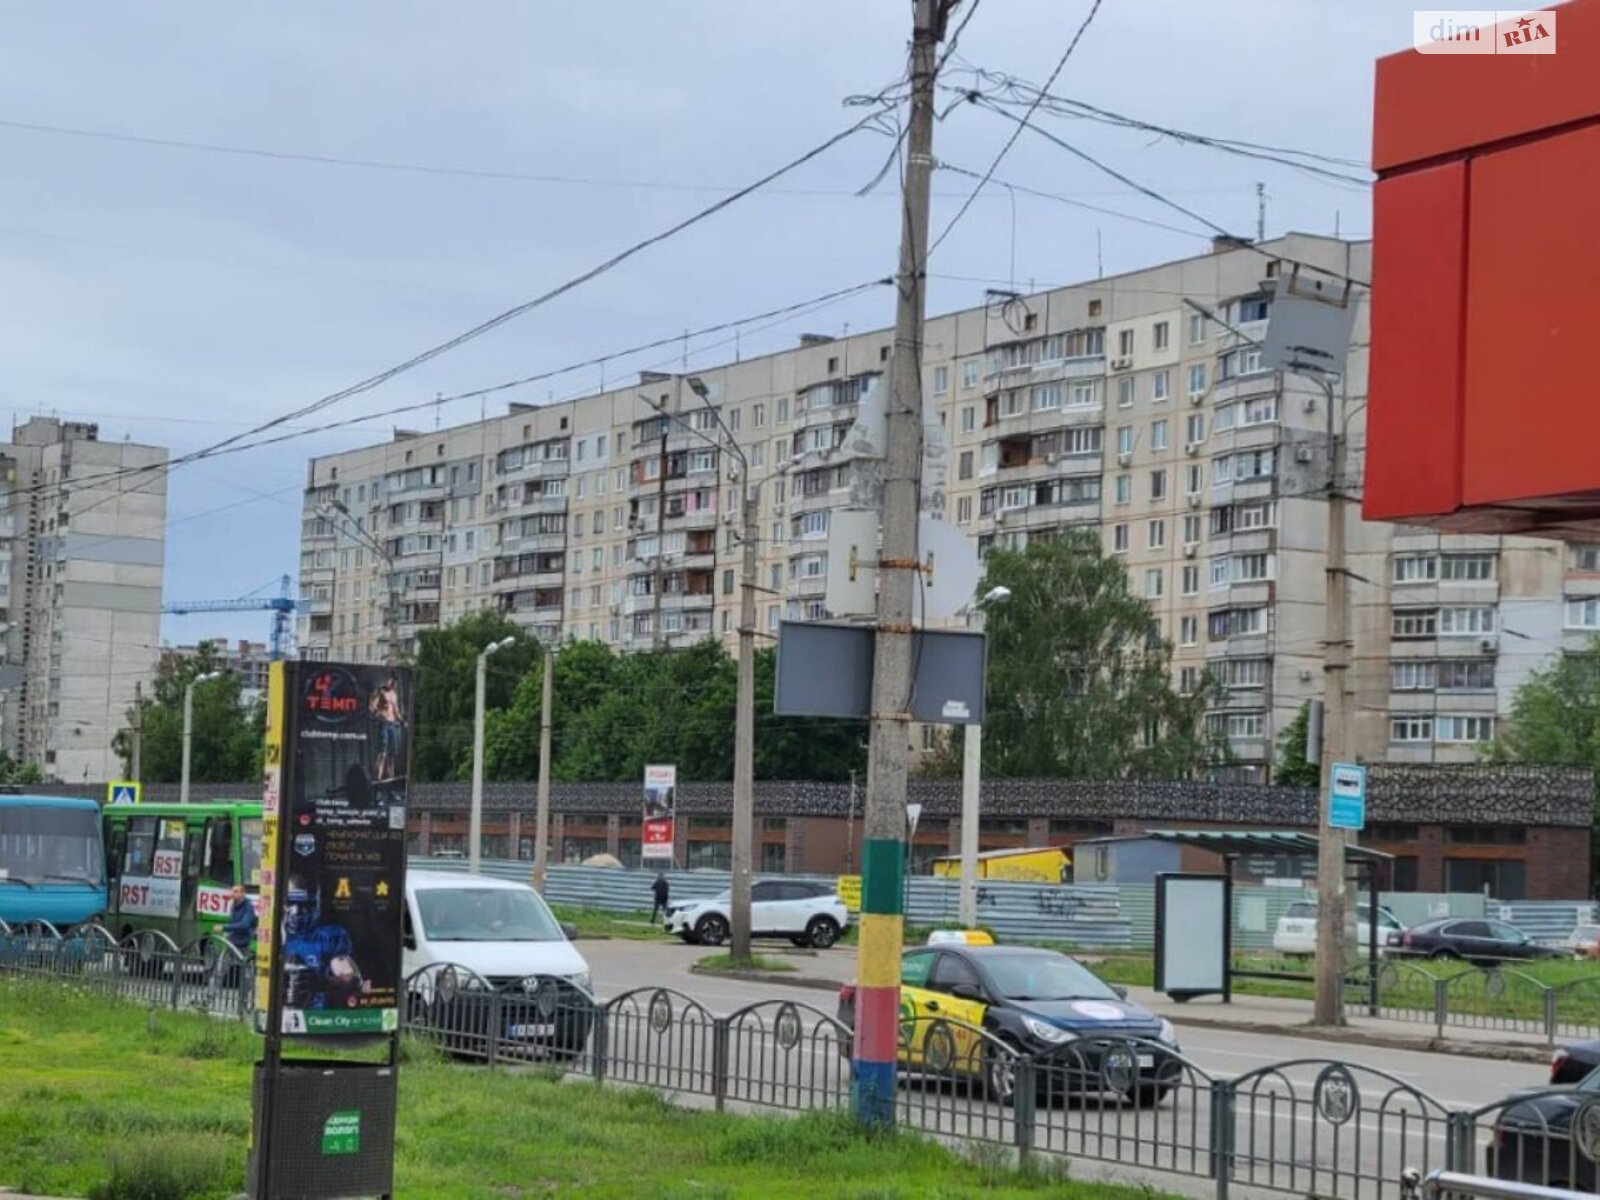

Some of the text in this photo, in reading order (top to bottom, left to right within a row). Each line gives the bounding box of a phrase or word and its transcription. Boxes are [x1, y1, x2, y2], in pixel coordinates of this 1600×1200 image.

[155, 856, 181, 875] RST
[121, 884, 149, 906] RST
[199, 891, 232, 913] RST
